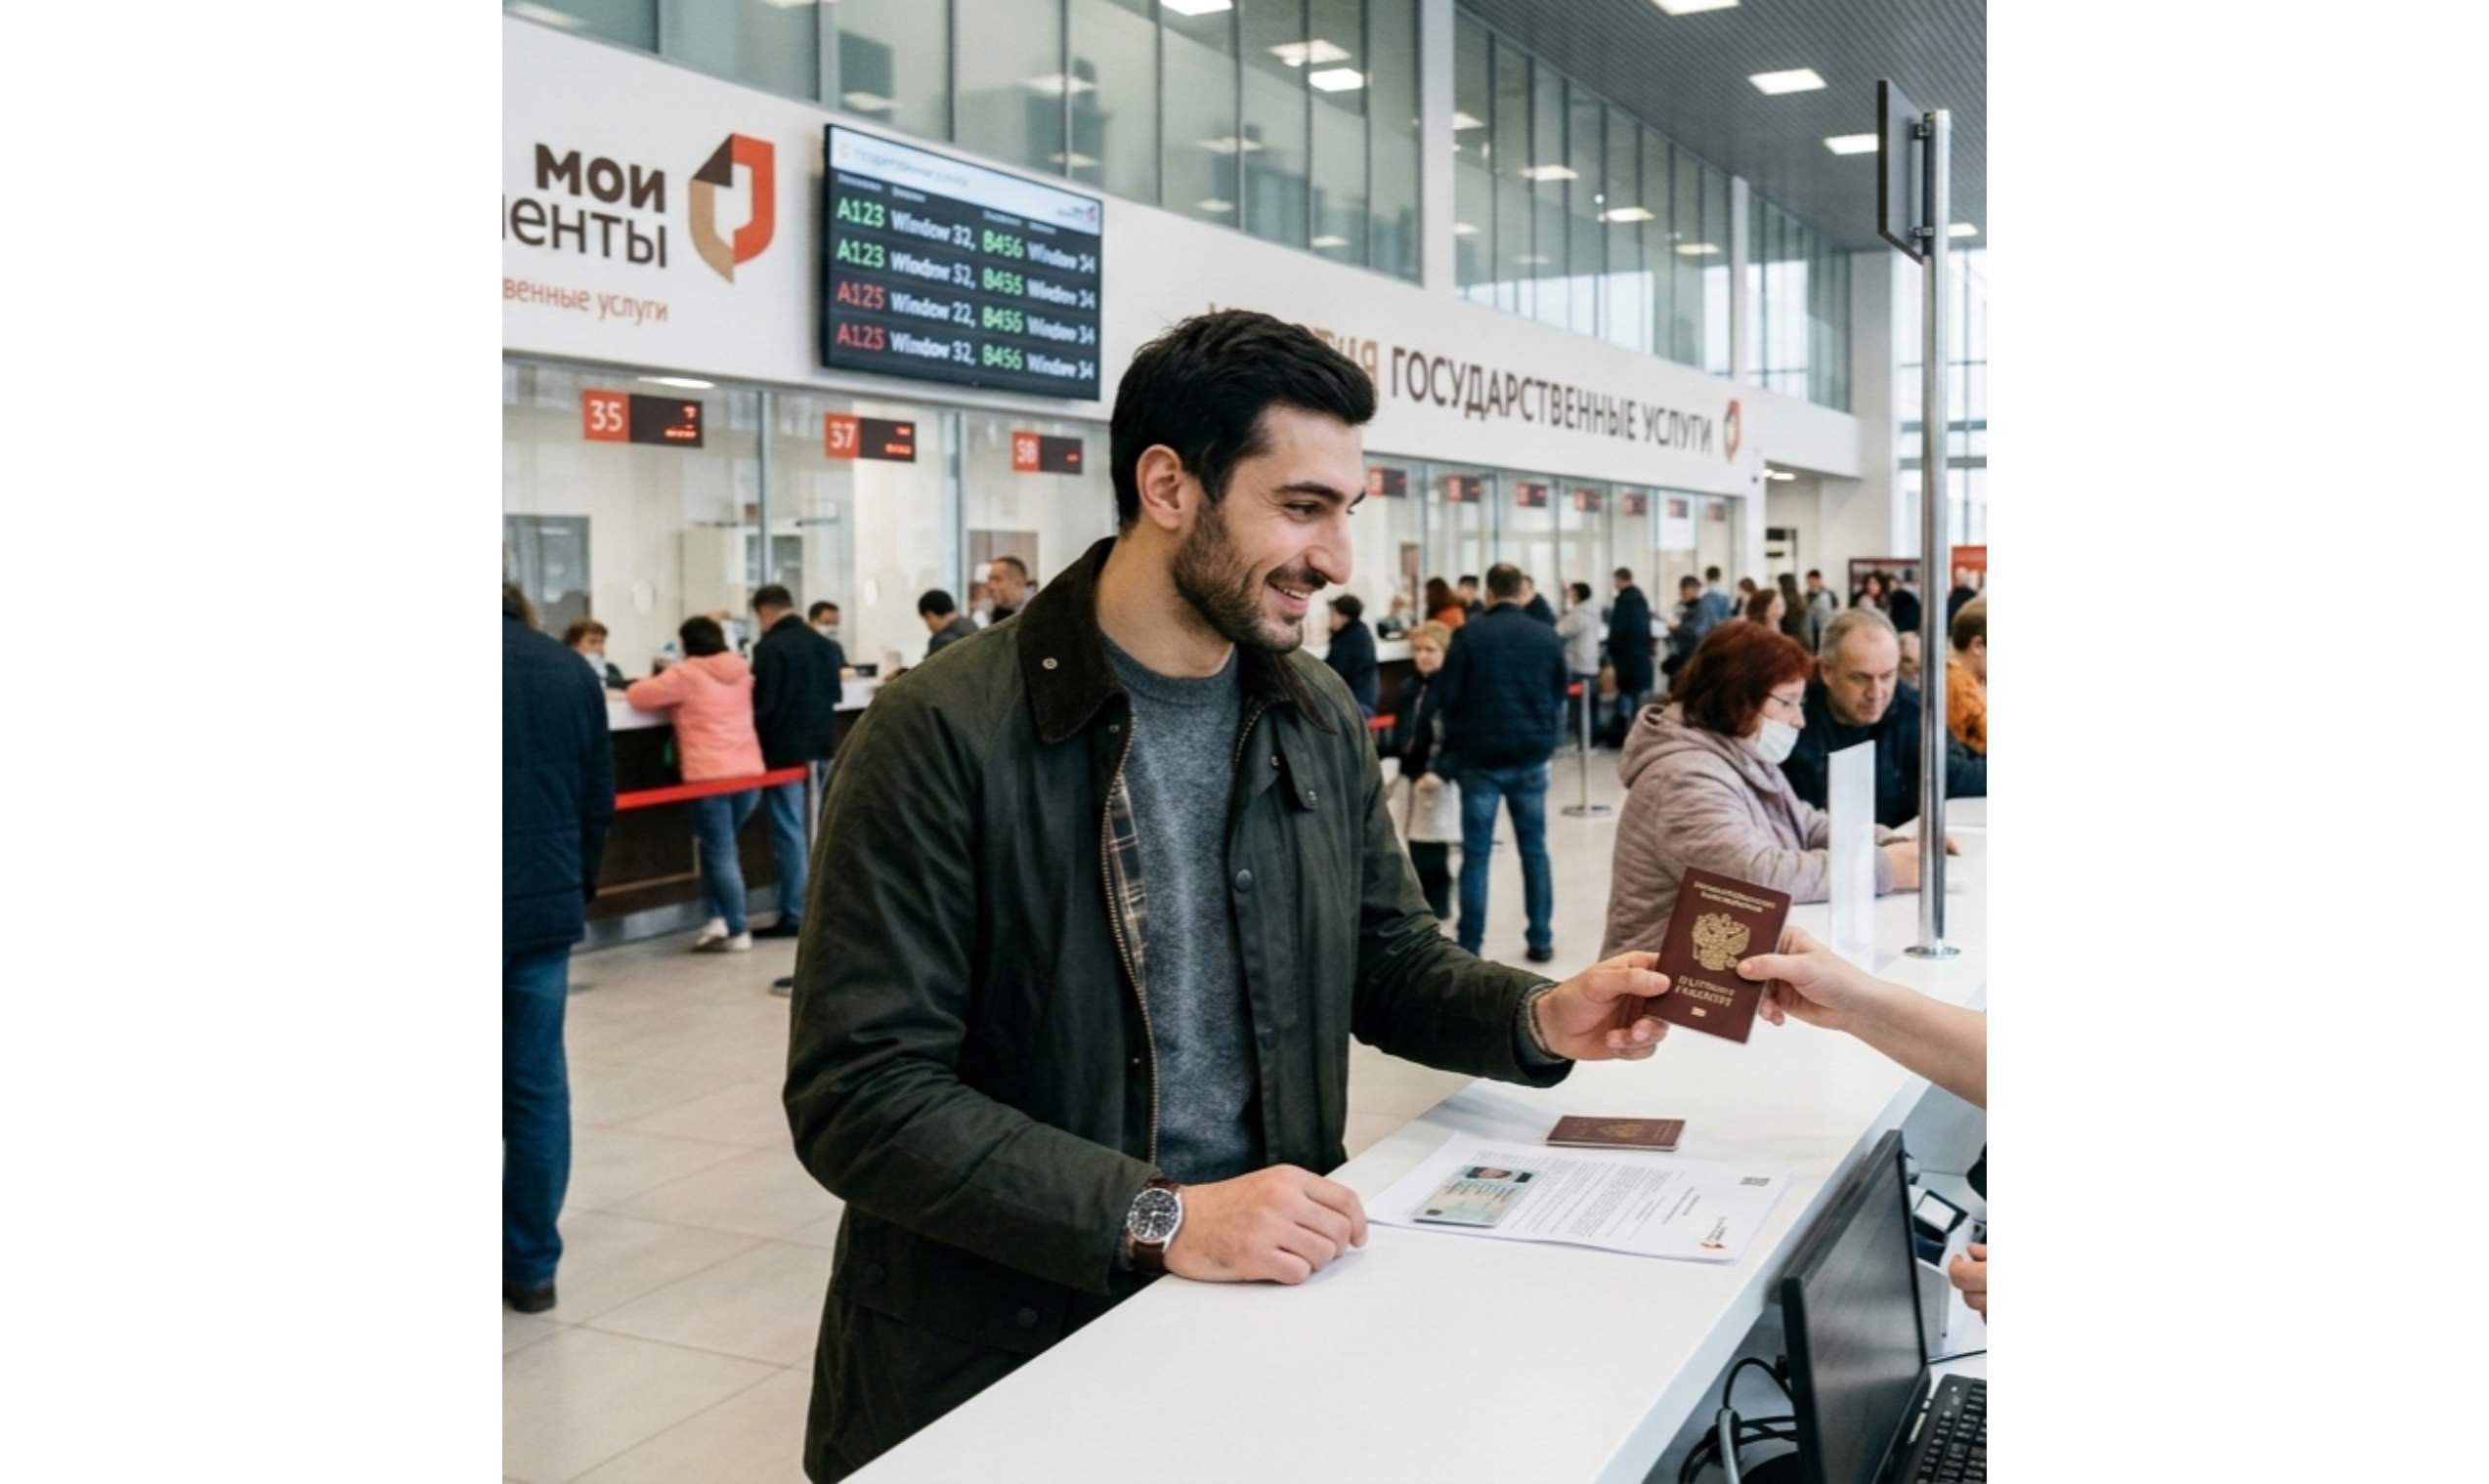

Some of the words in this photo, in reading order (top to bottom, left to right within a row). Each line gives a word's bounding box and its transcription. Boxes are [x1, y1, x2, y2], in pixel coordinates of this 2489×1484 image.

[502, 192, 666, 268] енты
[837, 197, 885, 228] A123
[890, 209, 951, 241] Window
[837, 239, 885, 269] A123
[598, 292, 668, 326] услуги
[890, 292, 951, 320] Window
[889, 331, 951, 360] Window
[1392, 346, 1636, 441] ГОСУДАРСТВЕННЫЕ
[1642, 402, 1712, 452] УСЛУГИ
[590, 400, 622, 432] 35
